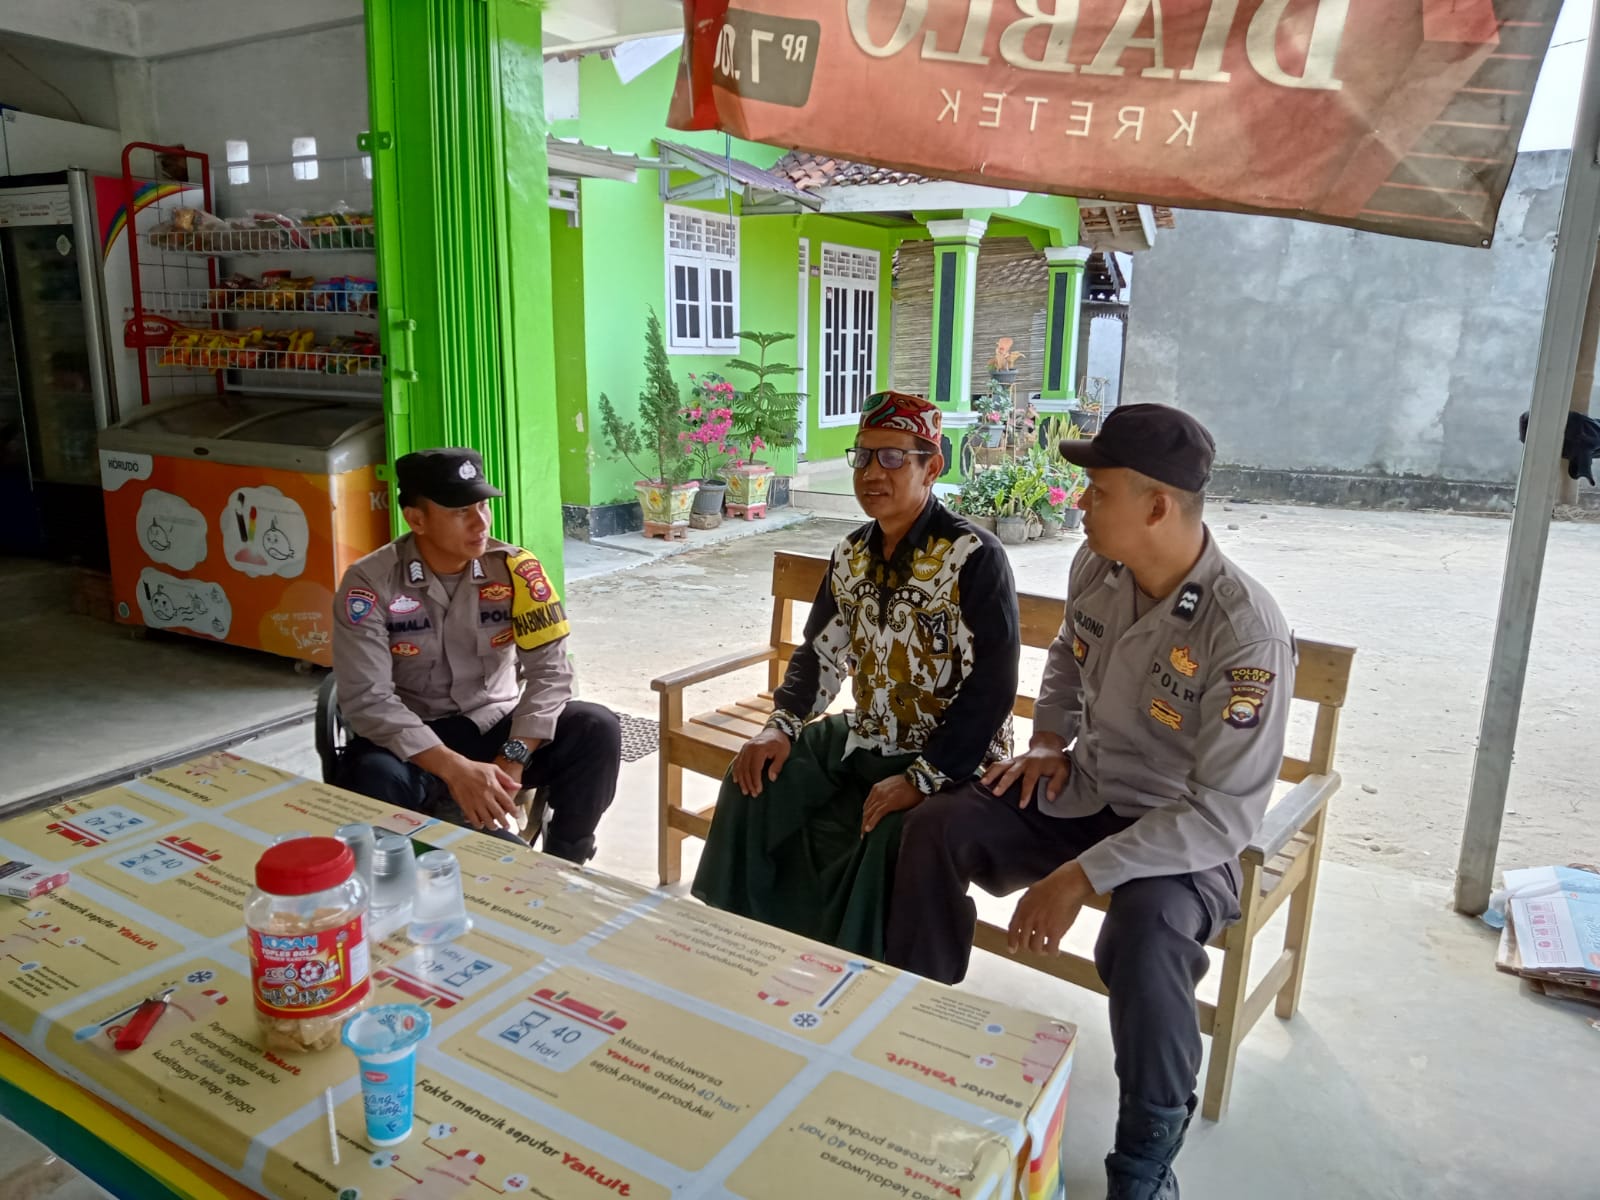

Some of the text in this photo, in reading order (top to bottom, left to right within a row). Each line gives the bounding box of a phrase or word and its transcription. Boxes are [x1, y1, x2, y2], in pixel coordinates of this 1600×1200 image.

[1231, 669, 1271, 680] POLRES
[118, 926, 158, 951] Yakult
[529, 1040, 561, 1059] Hari
[551, 1026, 583, 1045] 40
[152, 1049, 200, 1081] kualitasnya
[198, 1076, 224, 1095] tetap
[225, 1073, 250, 1087] agar
[230, 1056, 259, 1073] pada
[256, 1068, 281, 1085] suhu
[262, 1051, 302, 1076] Yakult
[606, 1048, 742, 1114] Yakult adalah 40 hari
[618, 1036, 724, 1088] Masa kedaluwarsa
[885, 1051, 1024, 1109] Yakult seputar
[589, 1058, 715, 1121] sejak proses produksi
[415, 1078, 453, 1104] Fakta
[451, 1096, 508, 1132] menarik
[504, 1126, 561, 1158] seputar
[559, 1151, 632, 1198] Yakult
[825, 1116, 887, 1147] produksi
[885, 1142, 938, 1167] proses
[819, 1151, 911, 1198] kedaluwarsa
[826, 1135, 848, 1150] 40
[847, 1144, 899, 1170] adalah
[903, 1167, 962, 1199] Yakult
